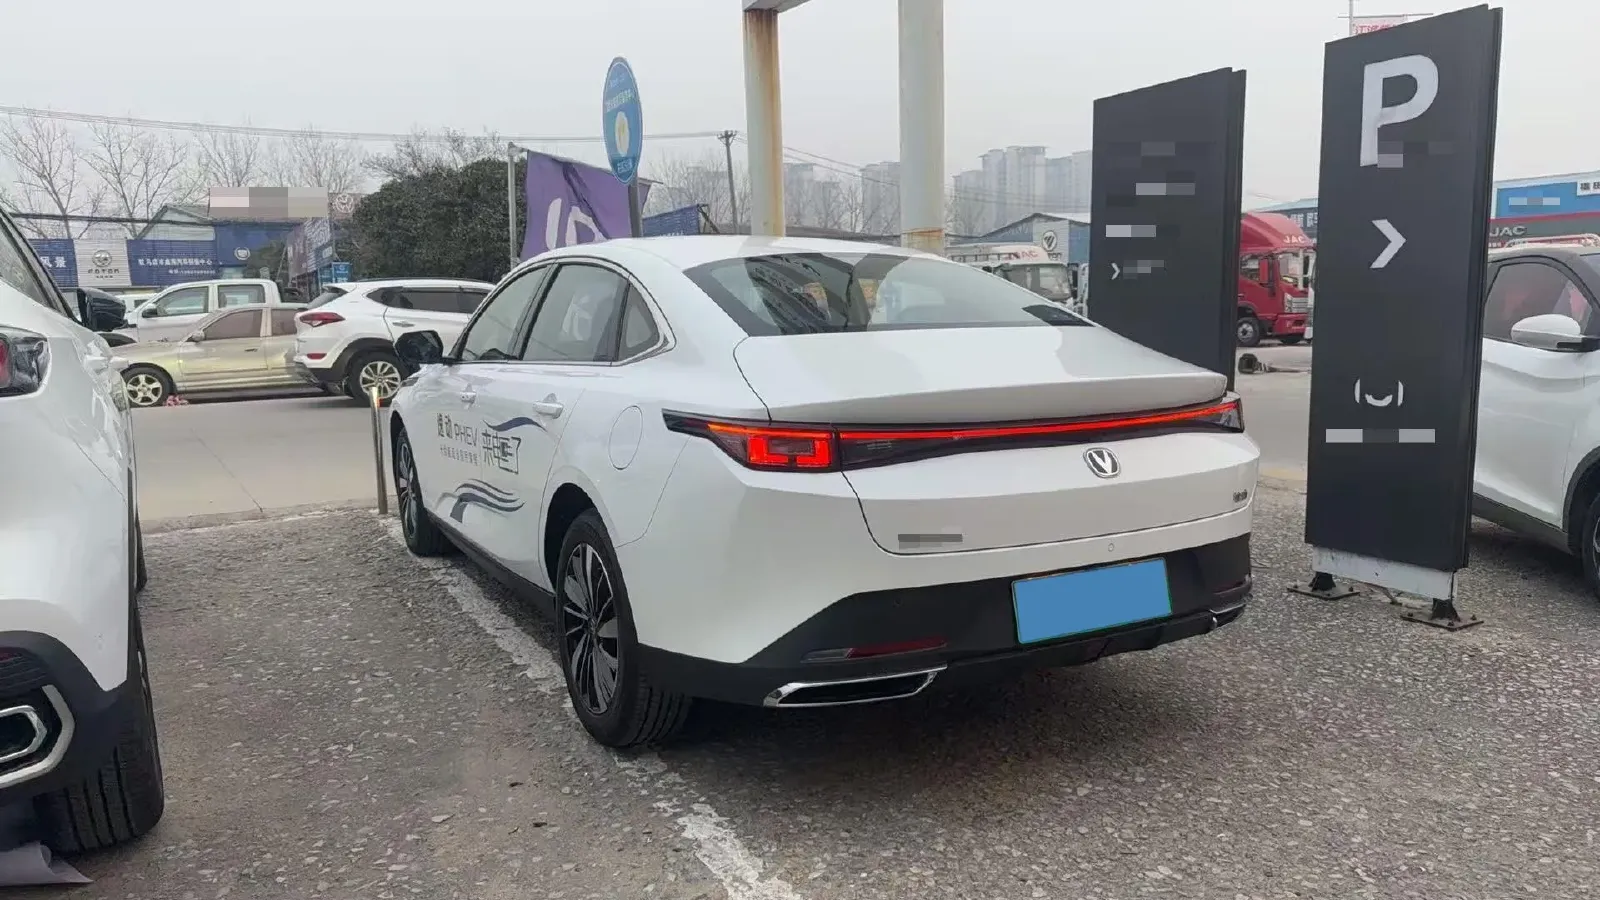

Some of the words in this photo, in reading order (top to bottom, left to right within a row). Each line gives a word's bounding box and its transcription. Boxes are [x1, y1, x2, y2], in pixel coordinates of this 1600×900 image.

[1360, 54, 1439, 167] P
[1283, 235, 1306, 244] JAC
[1489, 225, 1527, 237] JAC
[454, 423, 478, 447] PHEV
